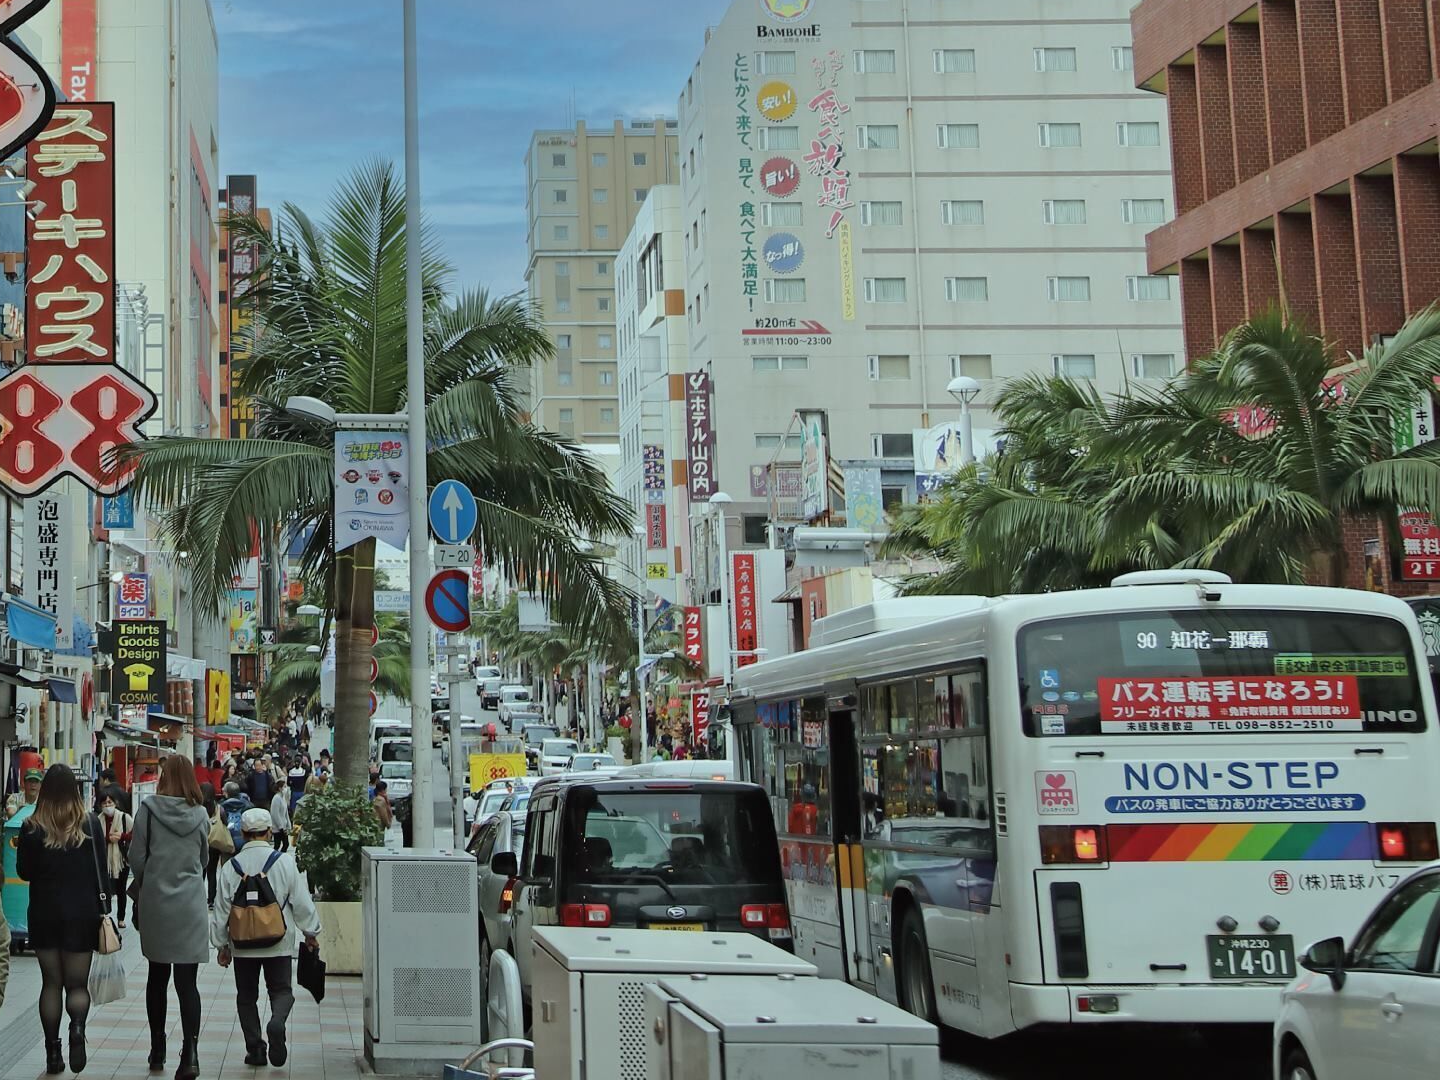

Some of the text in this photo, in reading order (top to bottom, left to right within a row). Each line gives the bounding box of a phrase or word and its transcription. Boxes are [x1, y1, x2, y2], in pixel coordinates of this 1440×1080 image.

[67, 61, 91, 102] Tax
[33, 107, 109, 360] ステーキハウス
[755, 317, 796, 328] 約20m右
[691, 396, 710, 494] ホテル山の内
[1403, 537, 1440, 556] 無料
[37, 499, 59, 615] 泡盛専門店
[1410, 561, 1437, 576] 2F
[120, 576, 148, 604] 薬
[118, 623, 160, 635] Tshirts
[118, 636, 160, 648] Goods
[1136, 632, 1157, 649] 90
[117, 648, 160, 660] Design
[119, 692, 159, 703] COSMIC
[1111, 680, 1344, 703] バス運転手になろう!
[1111, 705, 1211, 719] フリーガイド募集
[1126, 721, 1194, 732] 未経験者歓迎
[1209, 721, 1231, 731] TEL
[1123, 761, 1340, 791] NON-STEP
[1115, 796, 1356, 812] バスの発車にご協力ありがとうございます
[1231, 939, 1270, 949] 沖縄230
